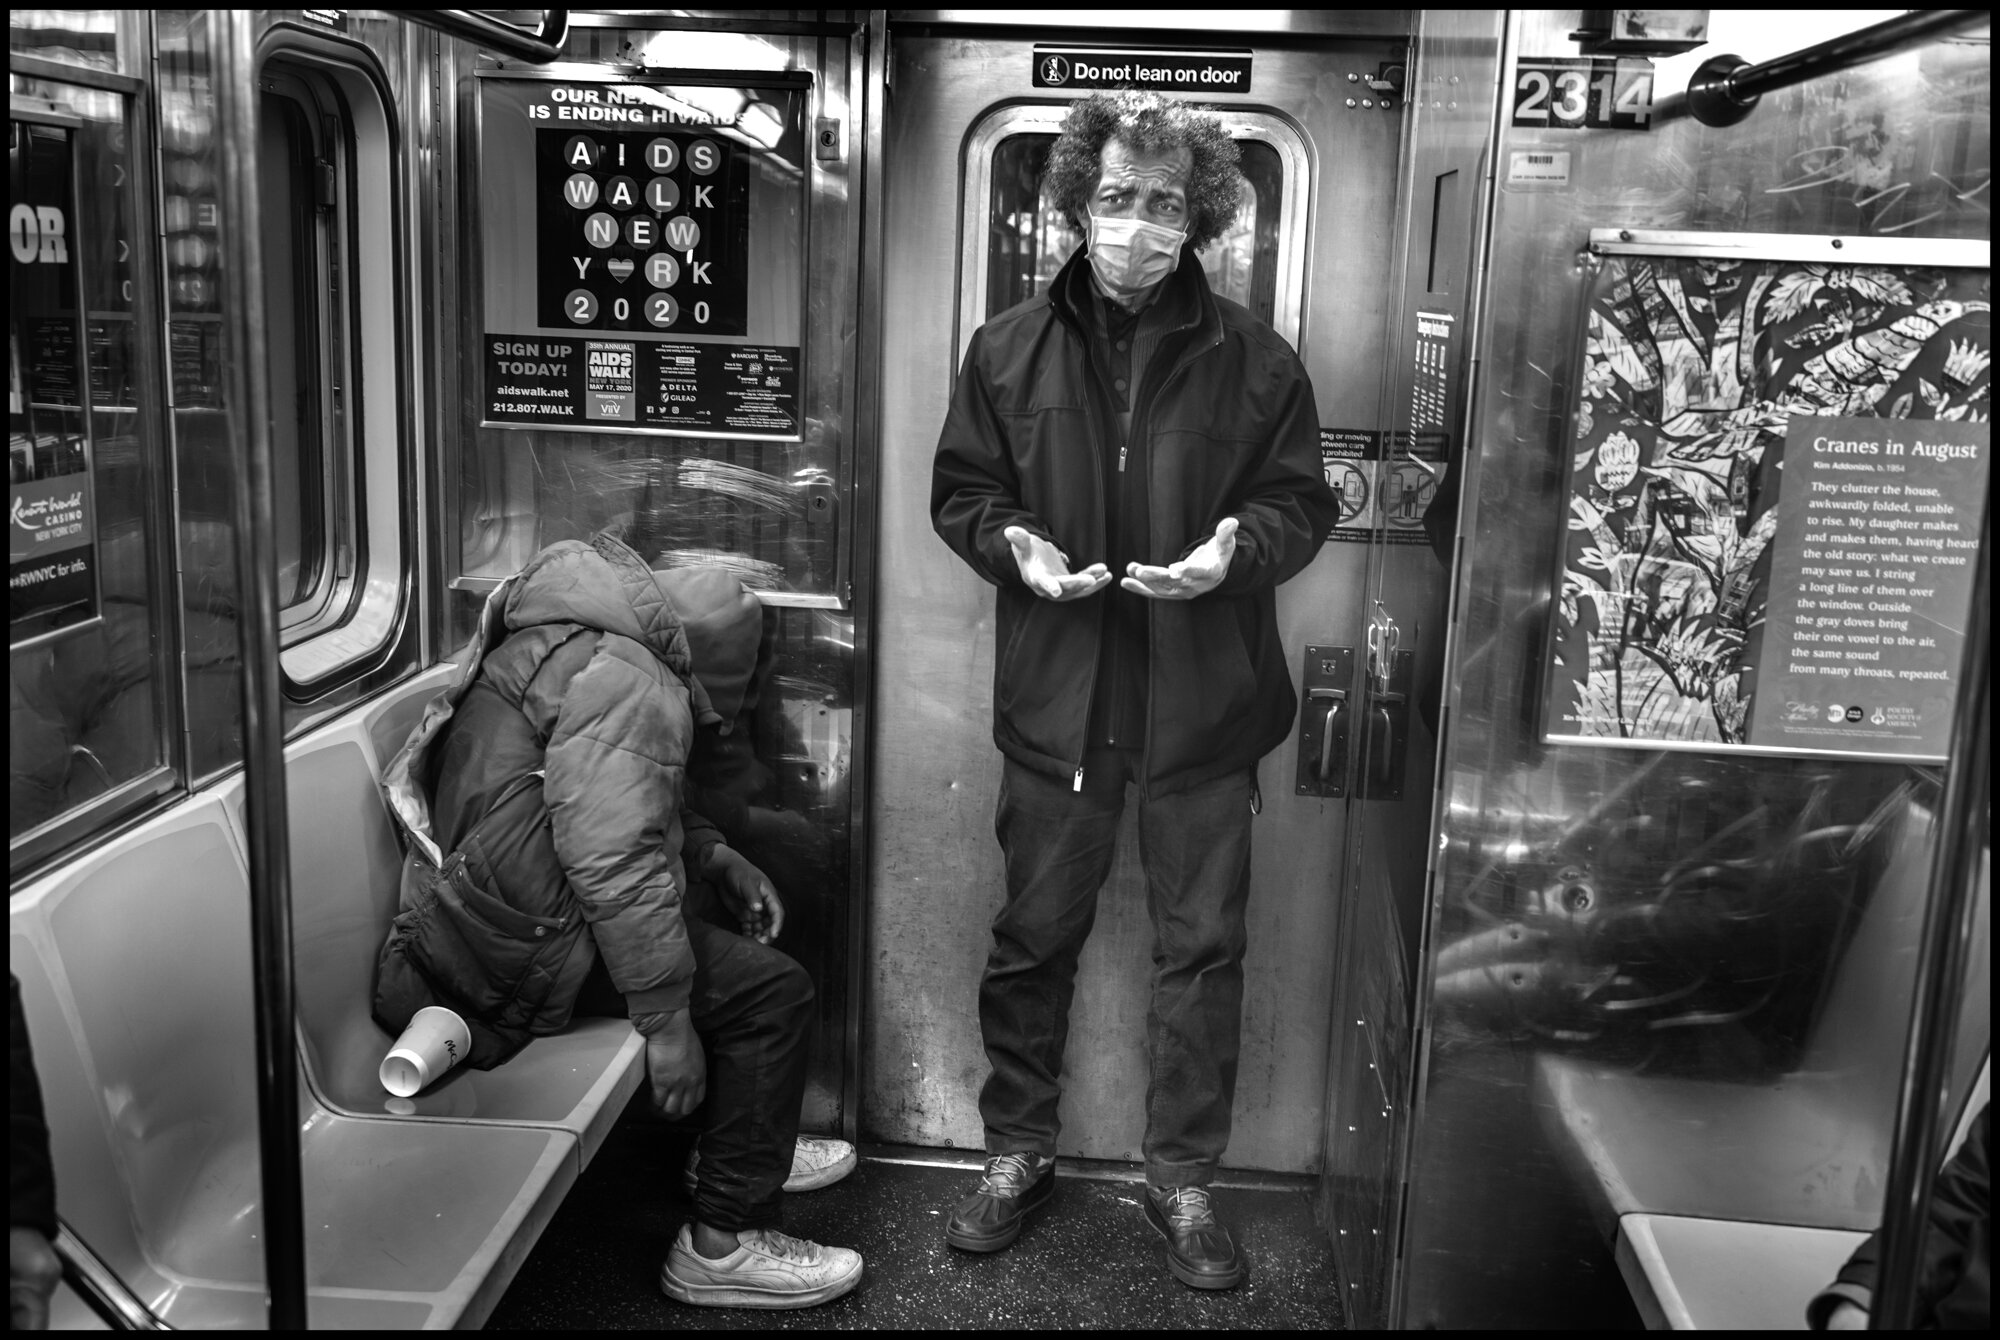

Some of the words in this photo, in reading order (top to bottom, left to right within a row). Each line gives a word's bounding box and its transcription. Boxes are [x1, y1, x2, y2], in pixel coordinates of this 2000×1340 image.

[1074, 62, 1100, 80] Do
[1102, 64, 1131, 80] not
[1135, 64, 1172, 82] lean
[1174, 68, 1197, 82] on
[1200, 66, 1242, 83] door
[551, 88, 599, 104] OUR
[1515, 71, 1651, 123] 2314
[529, 105, 550, 119] IS
[558, 106, 644, 122] ENDING
[571, 141, 713, 170] AIDS
[568, 180, 714, 208] WALK
[592, 220, 695, 246] NEW
[574, 296, 710, 324] 2020
[493, 342, 539, 357] SIGN
[546, 344, 572, 358] UP
[588, 352, 632, 366] AIDS
[498, 361, 567, 376] TODAY!
[589, 366, 631, 378] WALK
[497, 386, 569, 398] aidswalk.net
[493, 402, 574, 415] 212.807.WALK
[1321, 440, 1348, 448] etween
[1345, 434, 1371, 443] moving
[1326, 450, 1363, 458] prohibited
[1813, 436, 1879, 454] Cranes
[1885, 438, 1904, 455] in
[1911, 440, 1978, 462] August
[1811, 481, 1838, 495] They
[1841, 482, 1880, 494] clutter
[1882, 484, 1901, 495] the
[1808, 498, 1870, 513] awkwardly
[1915, 503, 1954, 514] unable
[45, 510, 82, 526] CASINO
[1806, 516, 1819, 525] to
[1848, 516, 1866, 530] My
[1868, 517, 1920, 531] daughter
[1922, 520, 1959, 531] makes
[35, 530, 50, 542] NEW
[51, 526, 68, 538] YORK
[69, 522, 82, 534] CITY
[1804, 532, 1827, 542] and
[1829, 533, 1866, 544] makes
[1905, 535, 1944, 550] having
[1802, 548, 1822, 559] the
[1824, 549, 1843, 560] old
[1880, 552, 1909, 563] what
[1912, 555, 1929, 564] we
[1930, 555, 1966, 565] create
[57, 563, 70, 576] for
[1801, 567, 1825, 578] may
[1828, 568, 1852, 577] save
[1875, 568, 1880, 578] I
[1882, 568, 1916, 583] string
[1799, 583, 1806, 591] a
[1809, 581, 1835, 595] long
[1837, 582, 1859, 594] line
[1861, 584, 1875, 594] of
[1876, 584, 1906, 596] them
[1909, 588, 1935, 597] over
[1797, 598, 1816, 608] the
[1868, 601, 1912, 613] Outside
[1795, 614, 1814, 624] the
[1815, 616, 1841, 628] gray
[1843, 616, 1875, 628] doves
[1878, 617, 1908, 632] bring
[1793, 630, 1820, 641] their
[1822, 633, 1844, 643] one
[1847, 634, 1880, 644] vowel
[1882, 636, 1894, 645] to
[1897, 635, 1916, 646] the
[1791, 647, 1810, 657] the
[1812, 649, 1842, 659] same
[1845, 650, 1880, 661] sound
[1789, 662, 1816, 674] from
[1819, 666, 1851, 678] many
